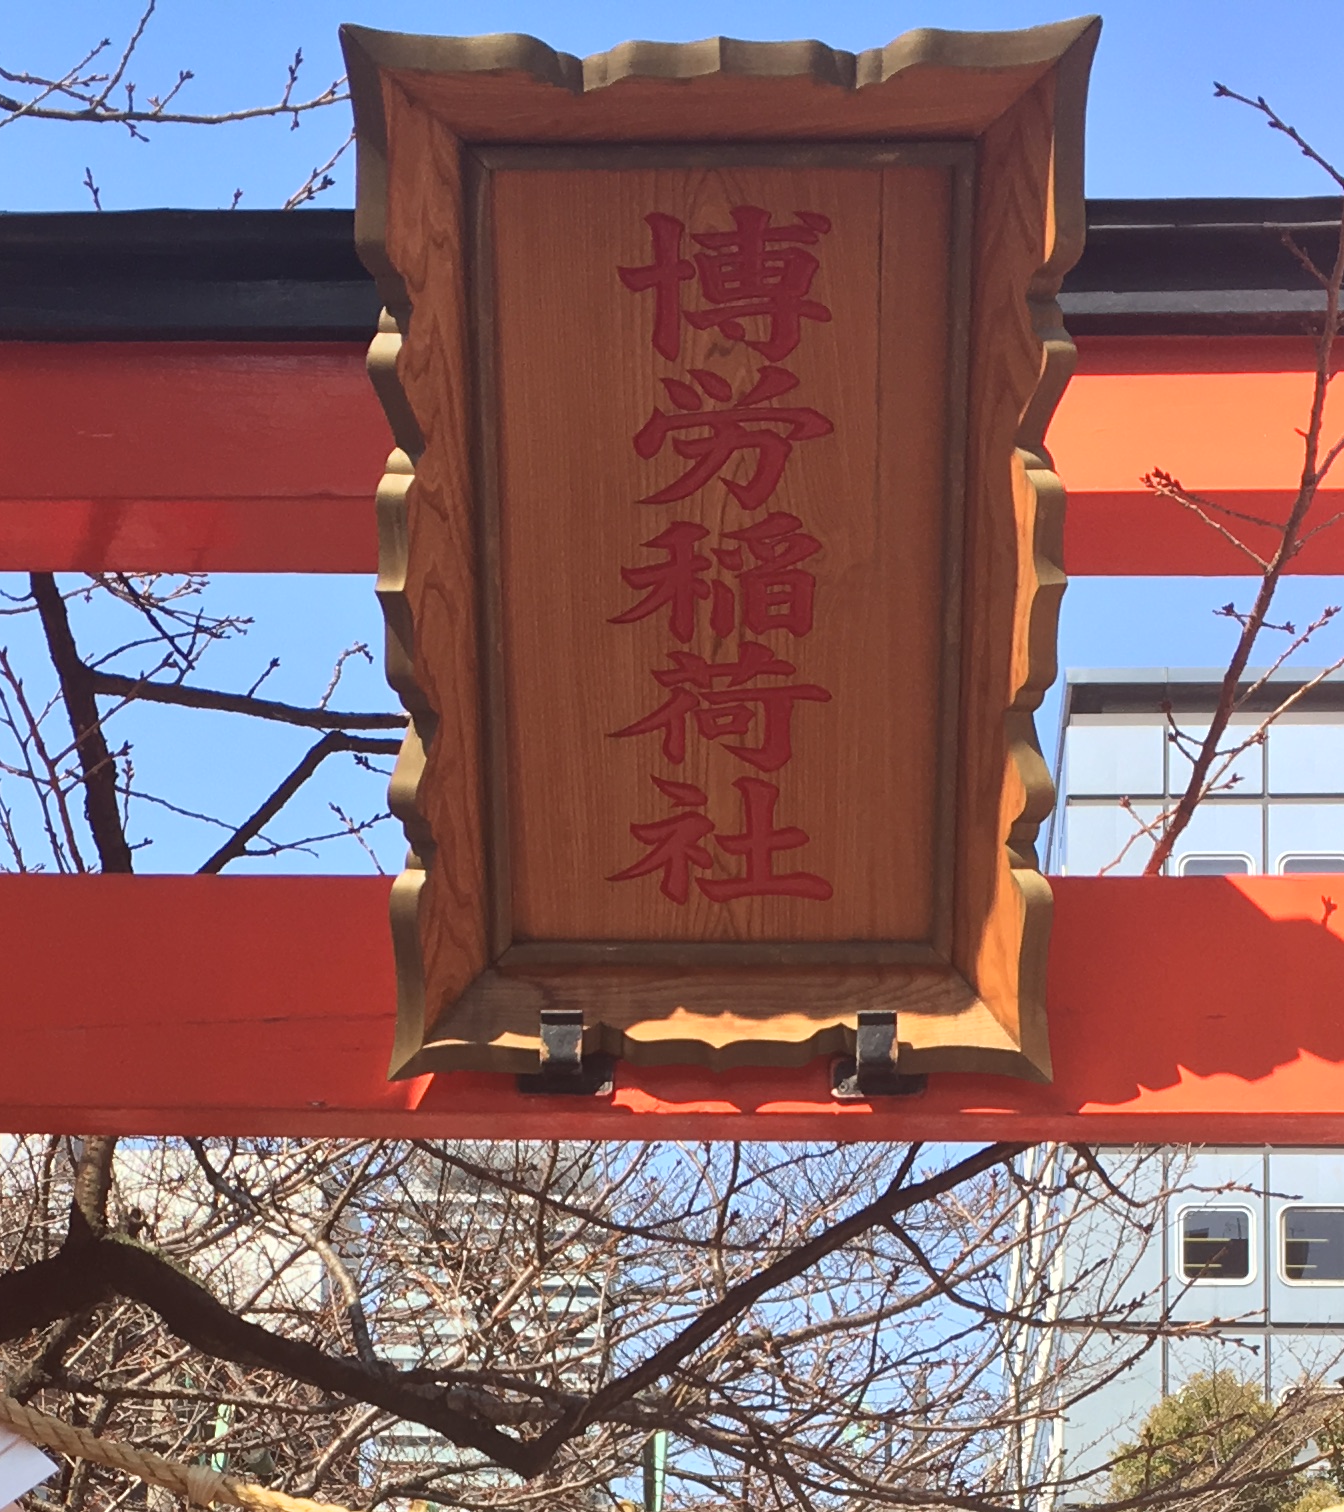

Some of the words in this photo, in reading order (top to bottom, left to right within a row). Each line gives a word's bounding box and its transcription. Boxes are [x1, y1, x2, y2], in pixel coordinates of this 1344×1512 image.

[606, 205, 833, 907] 博労稲荷社
